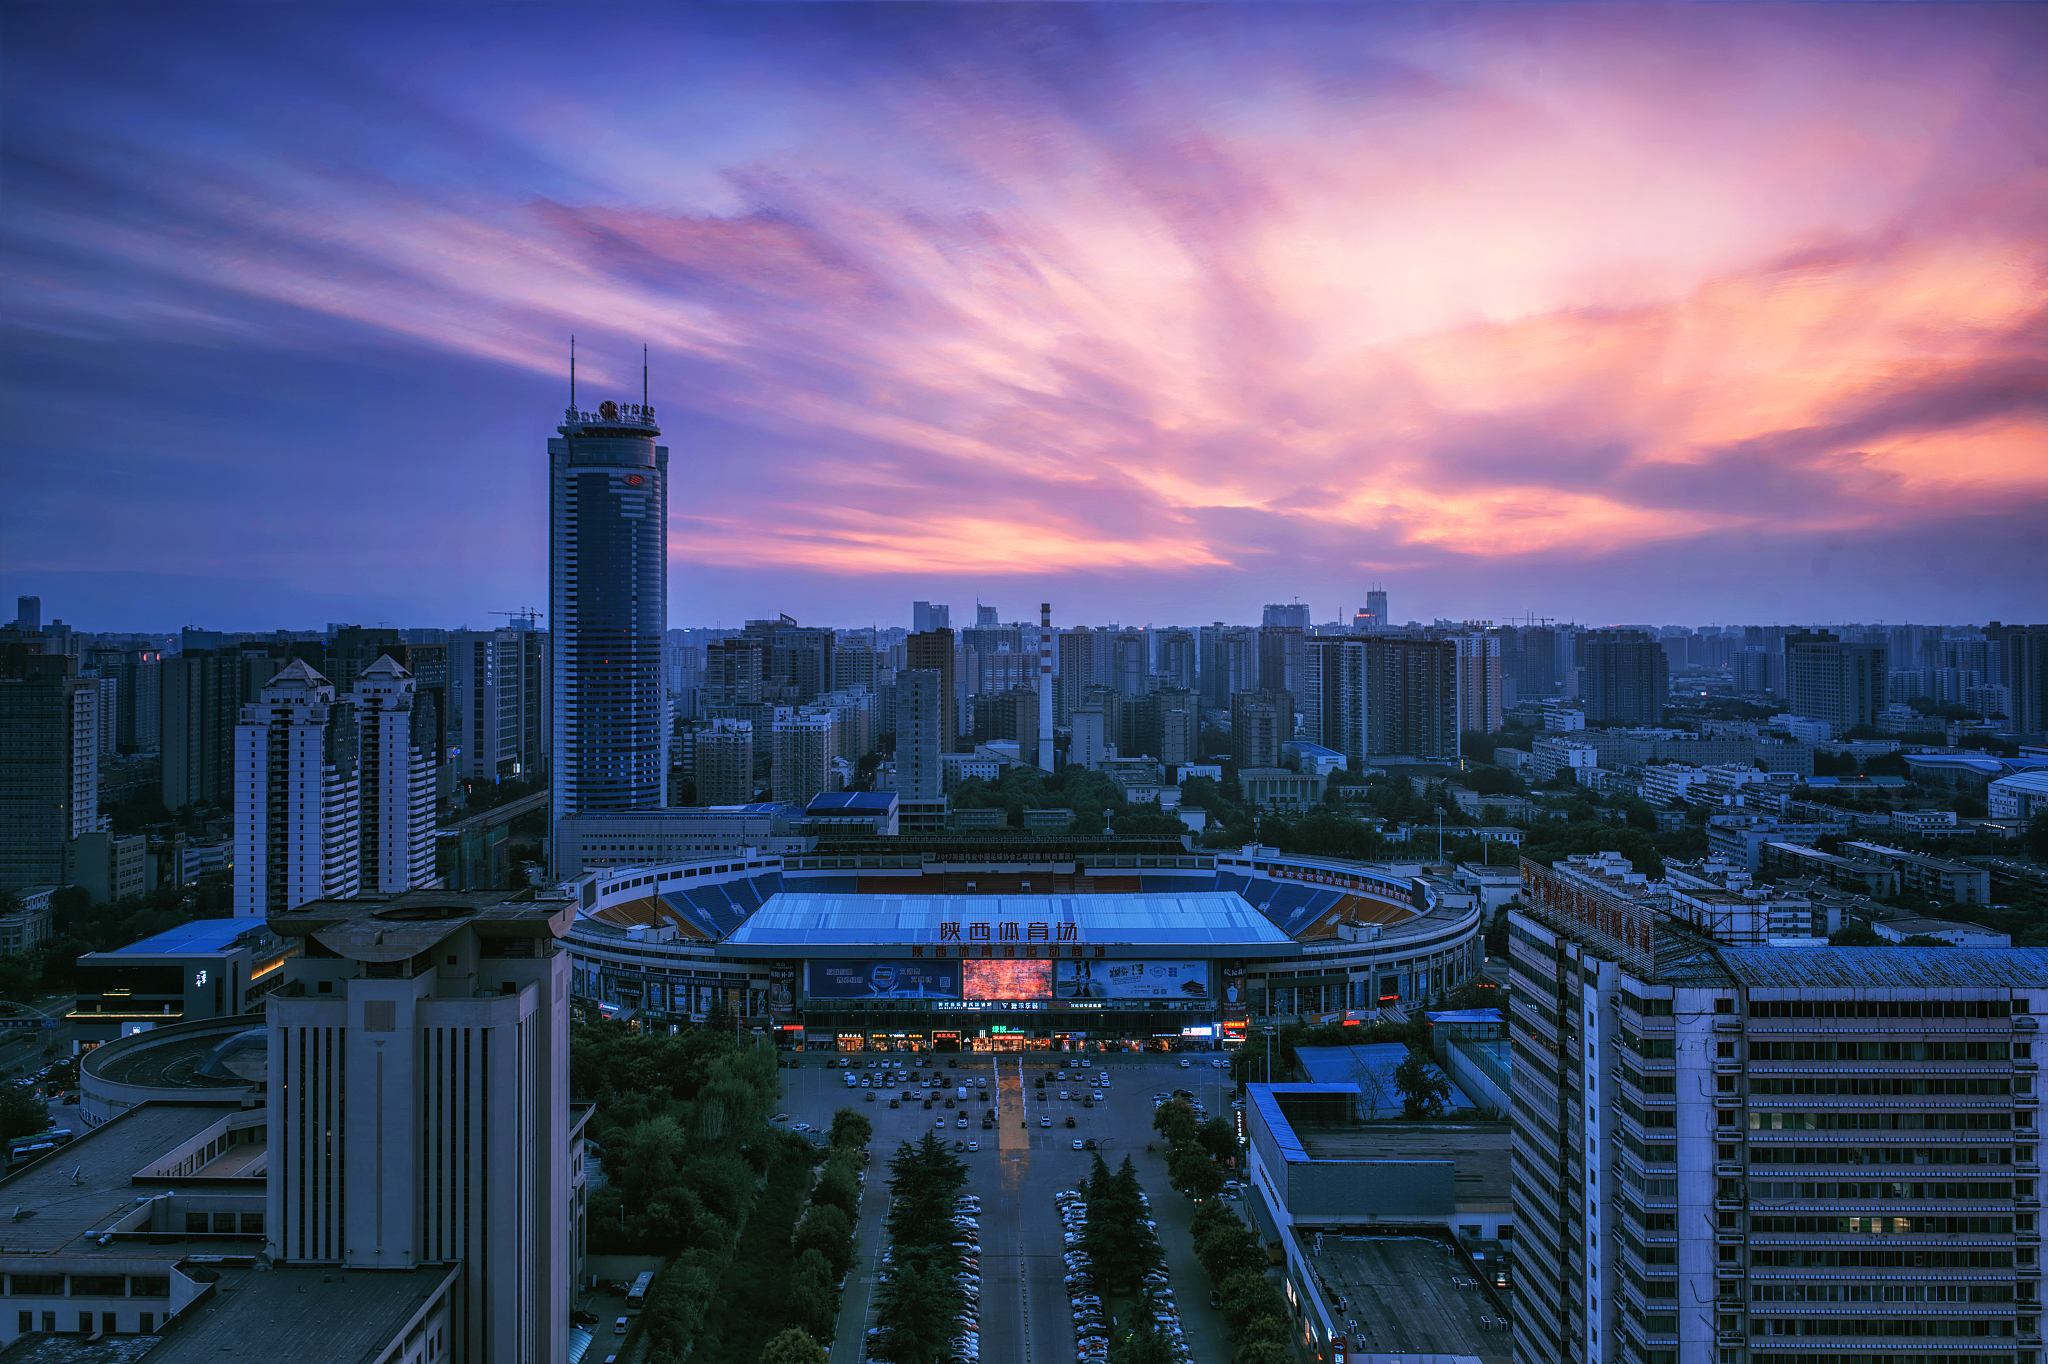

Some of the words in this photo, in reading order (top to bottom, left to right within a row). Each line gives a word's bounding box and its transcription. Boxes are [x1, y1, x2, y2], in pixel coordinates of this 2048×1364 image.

[1275, 869, 1352, 888] 落实全民健身战略
[1532, 872, 1650, 954] 西部投资集团有限公司
[939, 921, 1077, 942] 陕西体育场
[911, 945, 1106, 958] 陕西体育场运动商城
